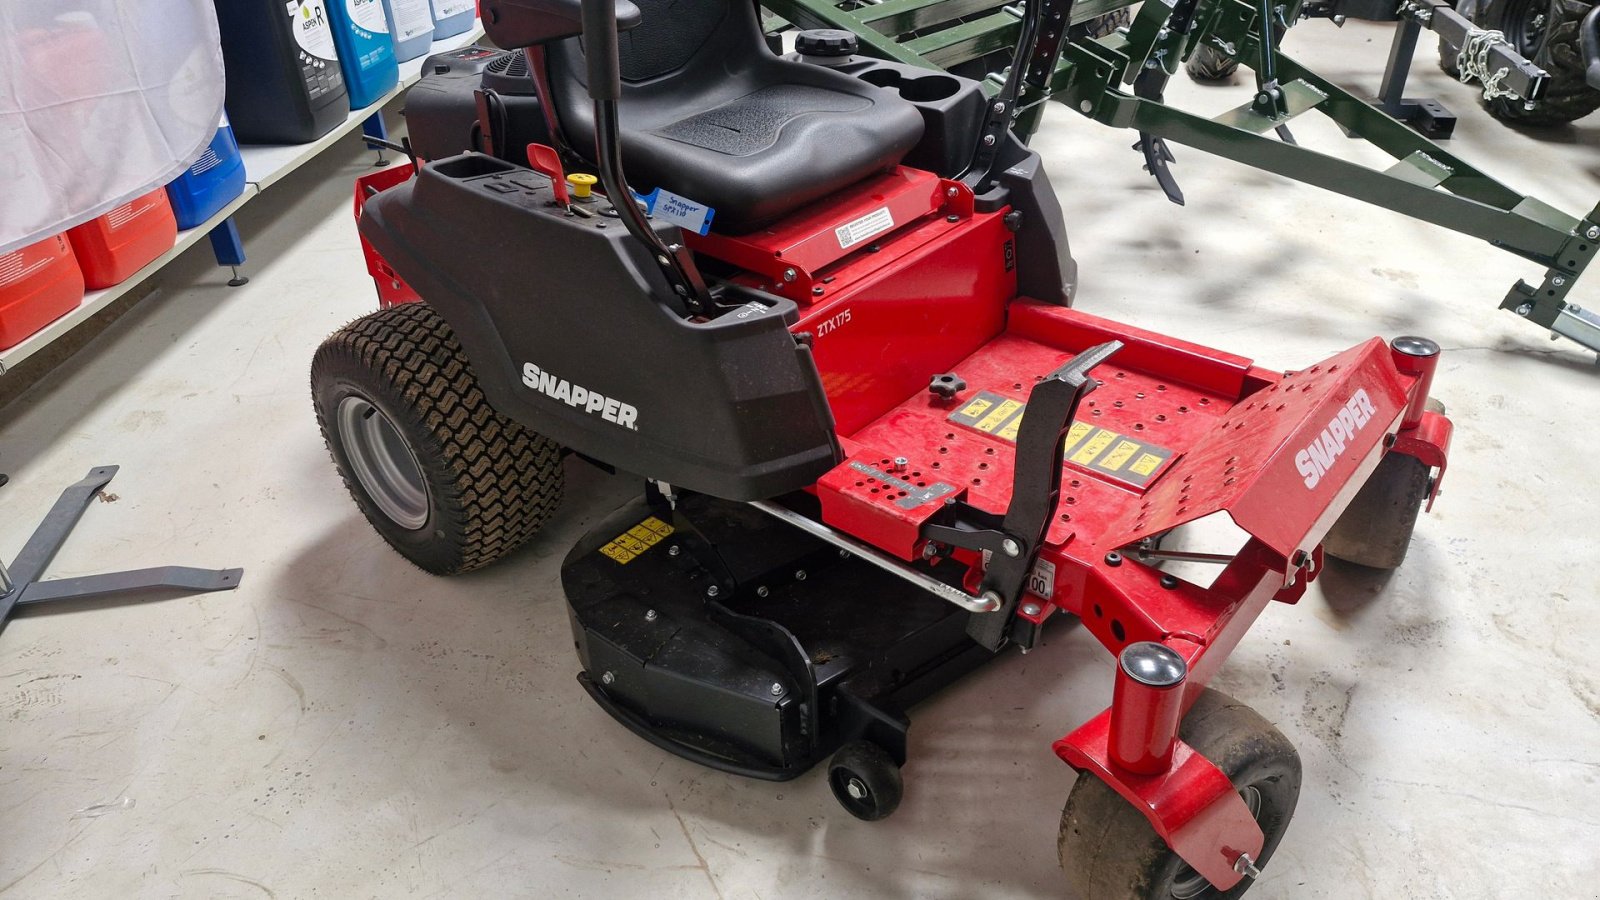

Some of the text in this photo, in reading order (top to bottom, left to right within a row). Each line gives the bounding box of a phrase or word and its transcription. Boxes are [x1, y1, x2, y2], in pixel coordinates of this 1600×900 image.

[302, 6, 325, 31] ASPEN R
[669, 197, 699, 212] Snapper
[522, 362, 638, 430] SNAPPER
[1294, 388, 1376, 490] SNAPPER
